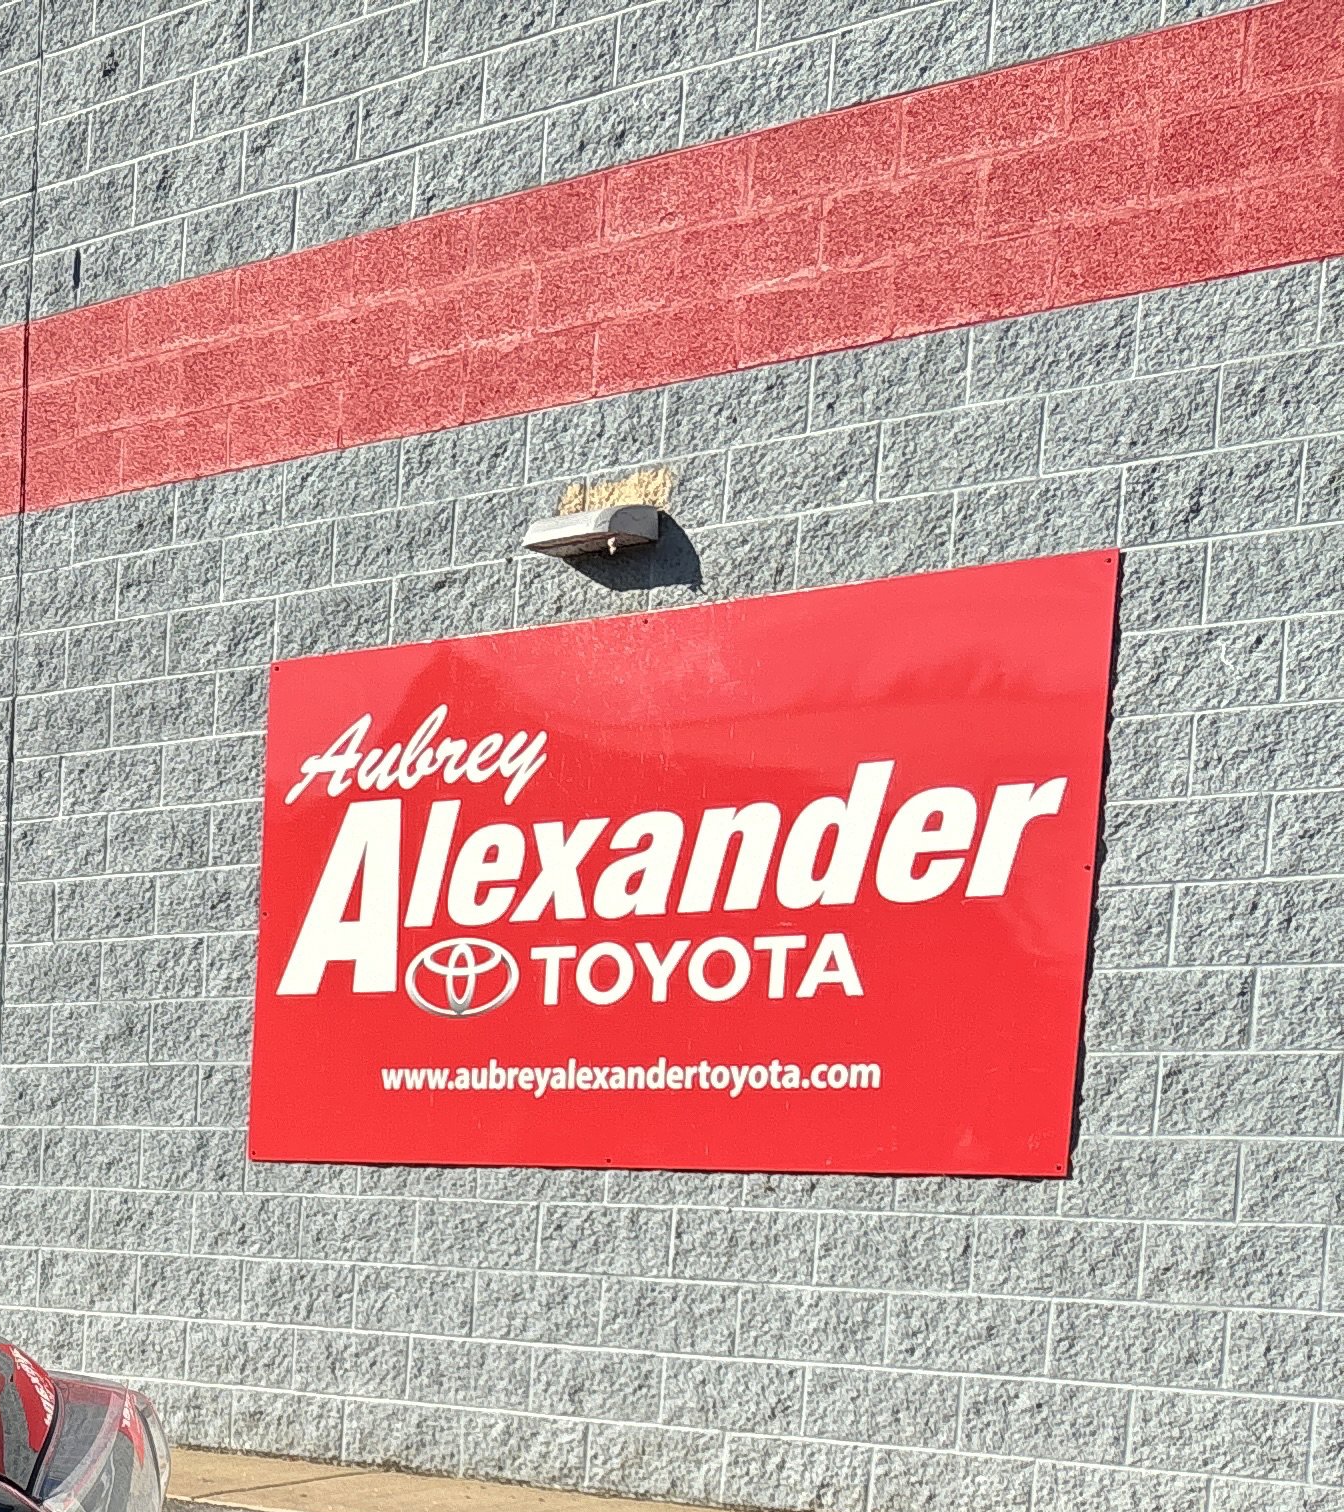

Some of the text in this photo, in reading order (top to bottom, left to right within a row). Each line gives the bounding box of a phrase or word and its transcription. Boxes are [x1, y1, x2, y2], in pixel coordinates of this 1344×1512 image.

[284, 704, 549, 806] Aubrey
[275, 759, 1069, 995] Alexander
[529, 933, 865, 1006] TOYOTA
[380, 1056, 882, 1099] www.aubreyalexandertoyota.com
